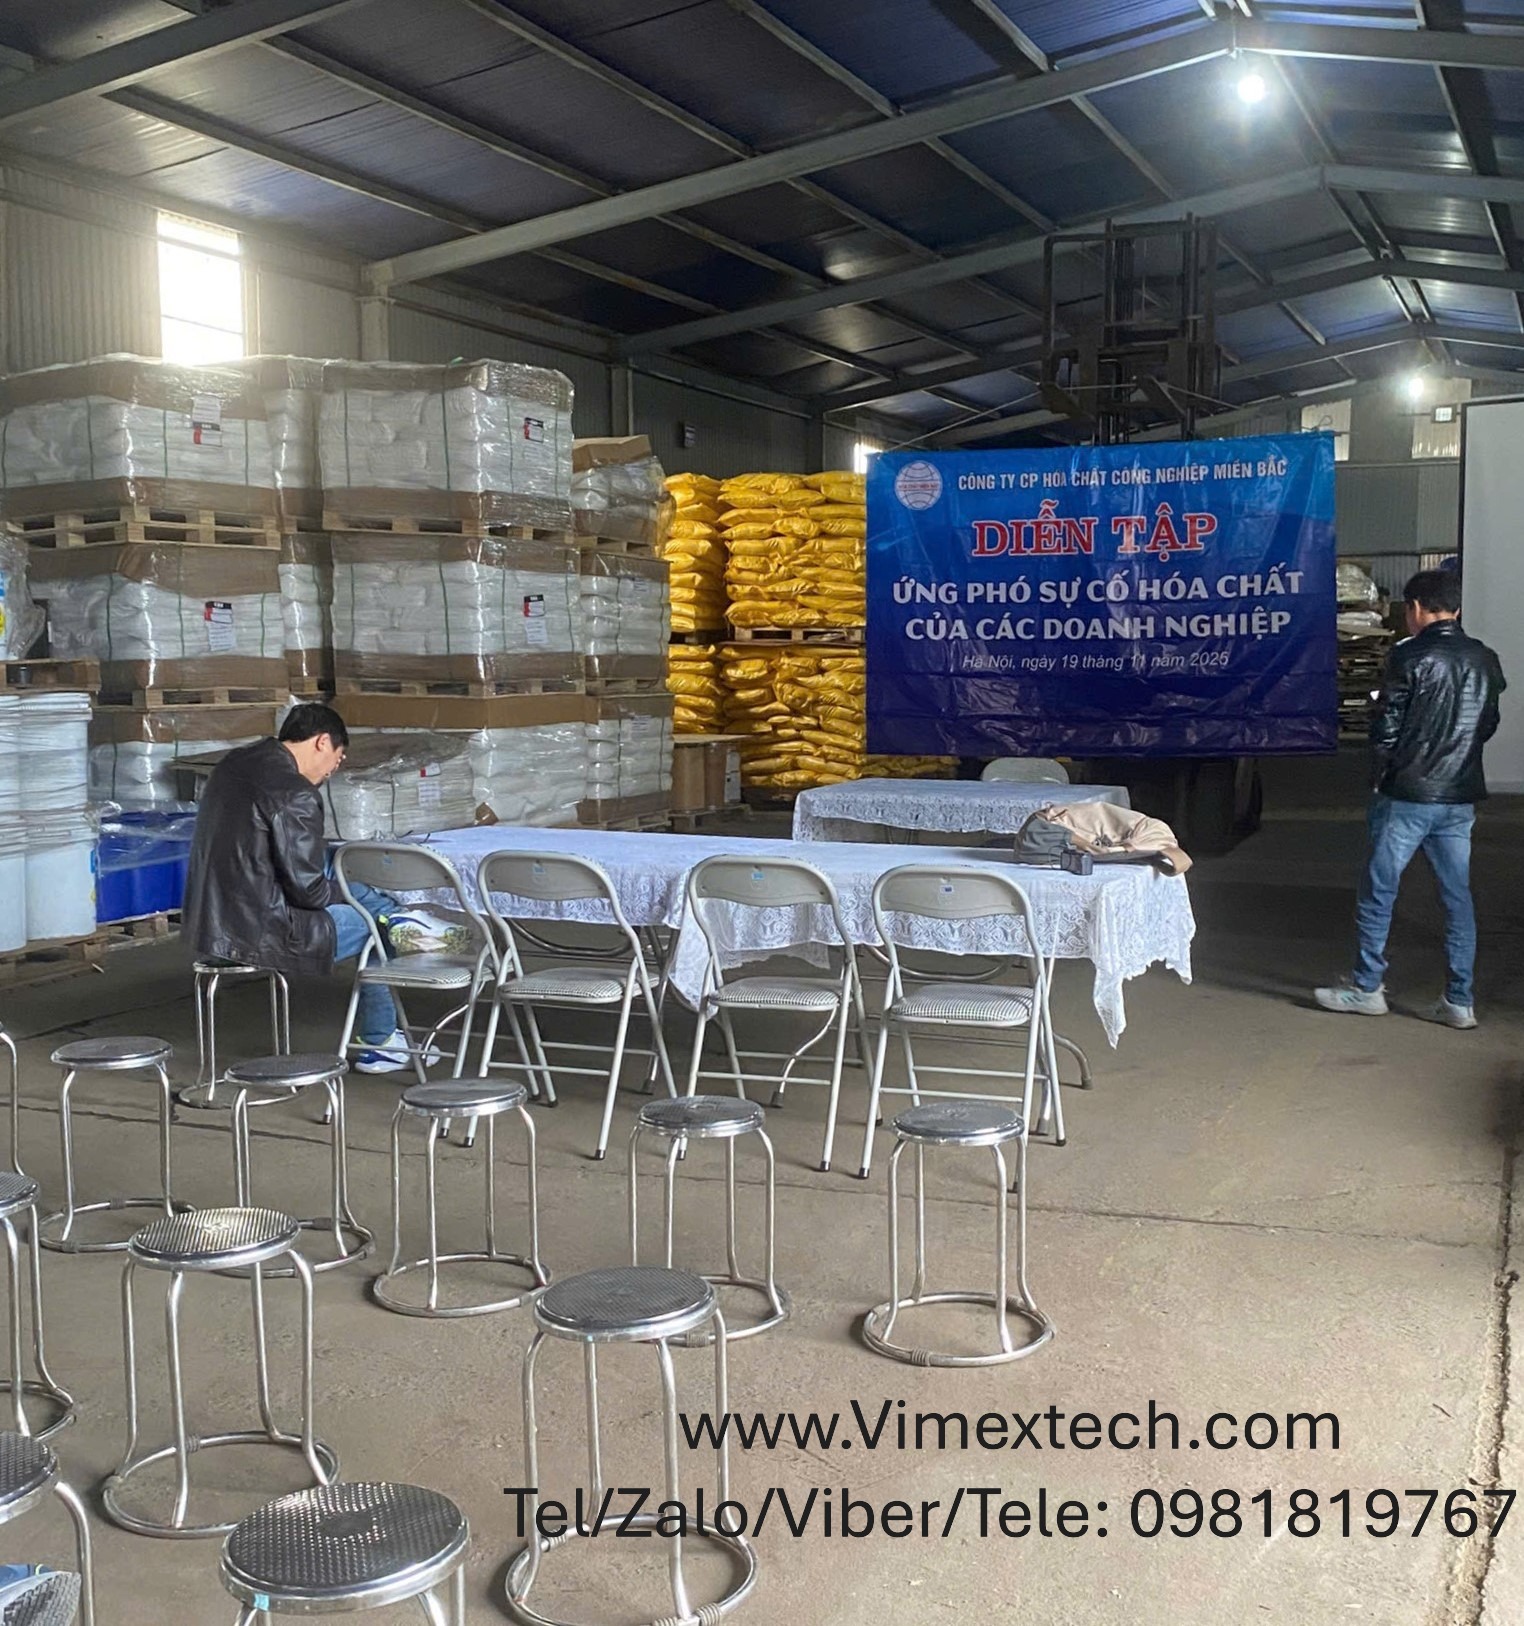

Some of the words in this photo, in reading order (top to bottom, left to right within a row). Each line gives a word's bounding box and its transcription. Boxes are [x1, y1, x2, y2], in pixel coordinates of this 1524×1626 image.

[958, 472, 996, 490] CÔNG
[1000, 474, 1015, 489] TY
[1020, 473, 1039, 488] CP
[1111, 467, 1151, 485] CÔNG
[1156, 463, 1209, 485] NGHIỆP
[972, 499, 1099, 556] DIỄN
[1111, 502, 1218, 562] TẬP
[893, 576, 958, 604] ỨNG
[967, 575, 1031, 603] PHÓ
[1039, 576, 1081, 608] SỰ
[1086, 569, 1130, 602] CỐ
[1138, 571, 1209, 600] HÓA
[1216, 562, 1304, 598] CHẤT
[905, 611, 969, 640] CỦA
[976, 612, 1035, 640] CÁC
[1043, 615, 1154, 640] DOANH
[1165, 605, 1291, 640] NGHIỆP
[1021, 654, 1056, 671] ngày
[1061, 654, 1078, 668] 19
[1082, 654, 1123, 671] tháng
[1190, 651, 1229, 667] 2025
